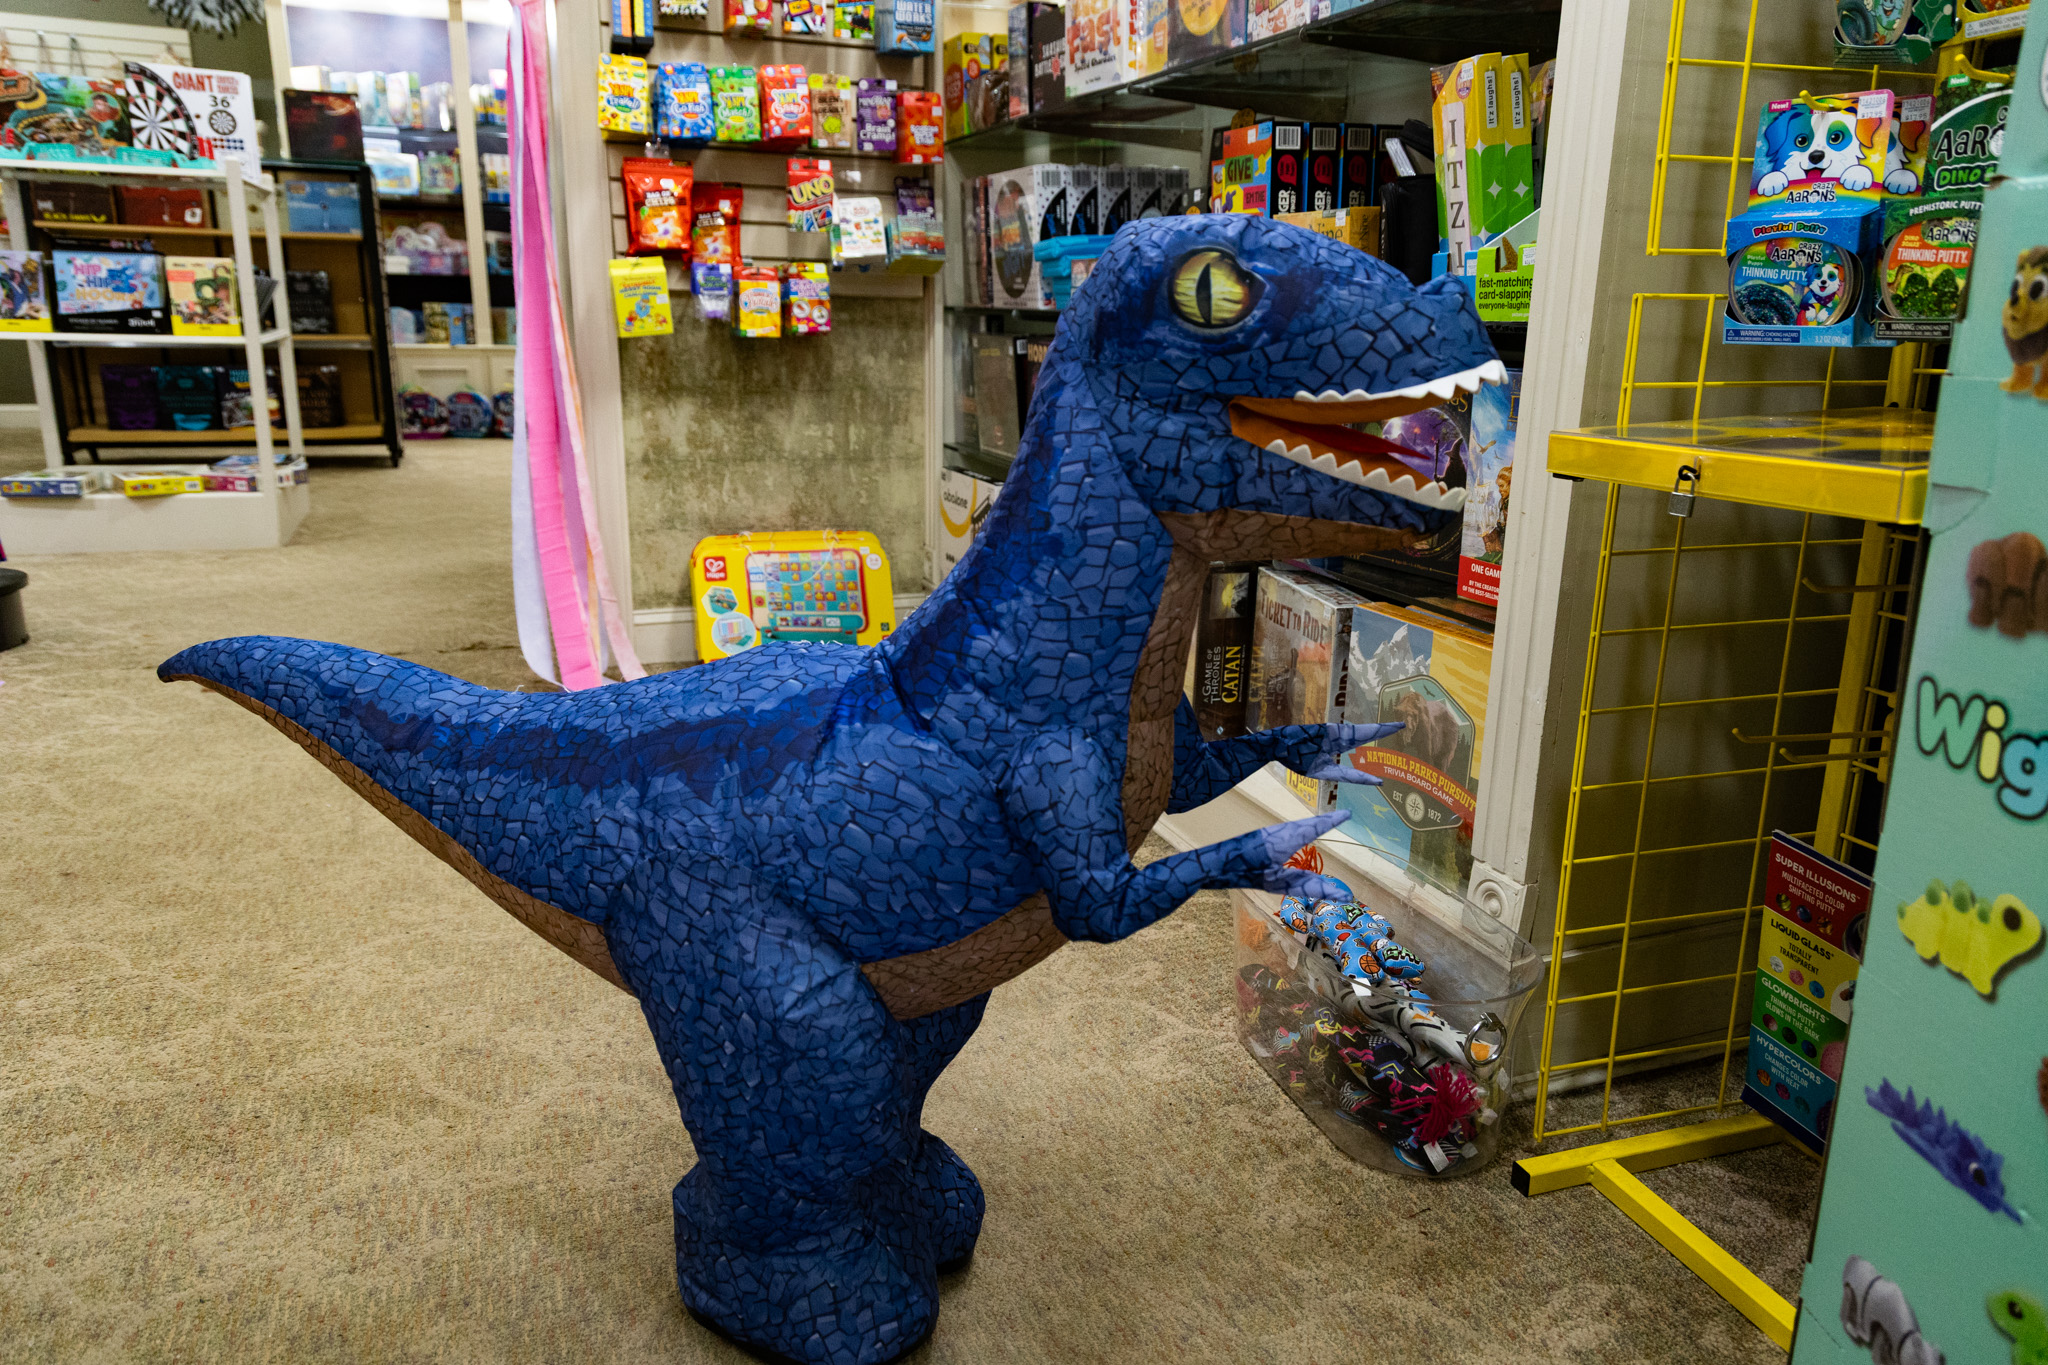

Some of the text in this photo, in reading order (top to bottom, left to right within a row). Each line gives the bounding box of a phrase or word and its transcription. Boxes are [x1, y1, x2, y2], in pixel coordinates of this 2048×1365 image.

[896, 10, 933, 24] WORKS
[173, 71, 213, 93] GIANT
[1771, 101, 1789, 111] New!
[860, 130, 896, 142] Cramp!
[865, 123, 892, 133] Brain
[1227, 158, 1251, 182] GIVE
[1940, 169, 1981, 186] DINO
[791, 174, 835, 205] UNO
[1909, 200, 1959, 217] PREHISTORIC
[1753, 222, 1828, 237] Playful Putty
[1897, 248, 1938, 261] THINKING
[74, 264, 102, 275] HIP
[1742, 266, 1778, 279] THINKING
[1471, 563, 1484, 575] ONE
[1474, 581, 1482, 589] THE
[1261, 587, 1292, 630] TICKET
[1293, 613, 1302, 631] TO
[1207, 649, 1213, 659] OF
[1202, 662, 1213, 696] GAME
[1210, 646, 1221, 704] THRONES
[1222, 646, 1242, 703] CATAN
[1366, 751, 1477, 812] NATIONAL PARKS PURSUIT
[1383, 766, 1455, 806] TRIVIA BOARD GAME
[1392, 791, 1403, 803] EST.
[1427, 808, 1441, 823] 1872
[1775, 853, 1804, 875] SUPER
[1782, 871, 1845, 911] MULTIFACETED COLOR
[1788, 884, 1835, 916] SHIFTING PUTTY
[1771, 919, 1800, 941] LIQUID
[1780, 946, 1819, 975] TRANSPARENT
[1789, 942, 1812, 961] TOTALLY
[1765, 1001, 1820, 1041] GLOWS IN THE DARK
[1770, 994, 1815, 1029] THINKING PUTTY
[1756, 1035, 1821, 1085] HYPERCOLORS
[1765, 1053, 1808, 1088] CHANGES COLOR
[1771, 1066, 1800, 1090] WITH HEAT
